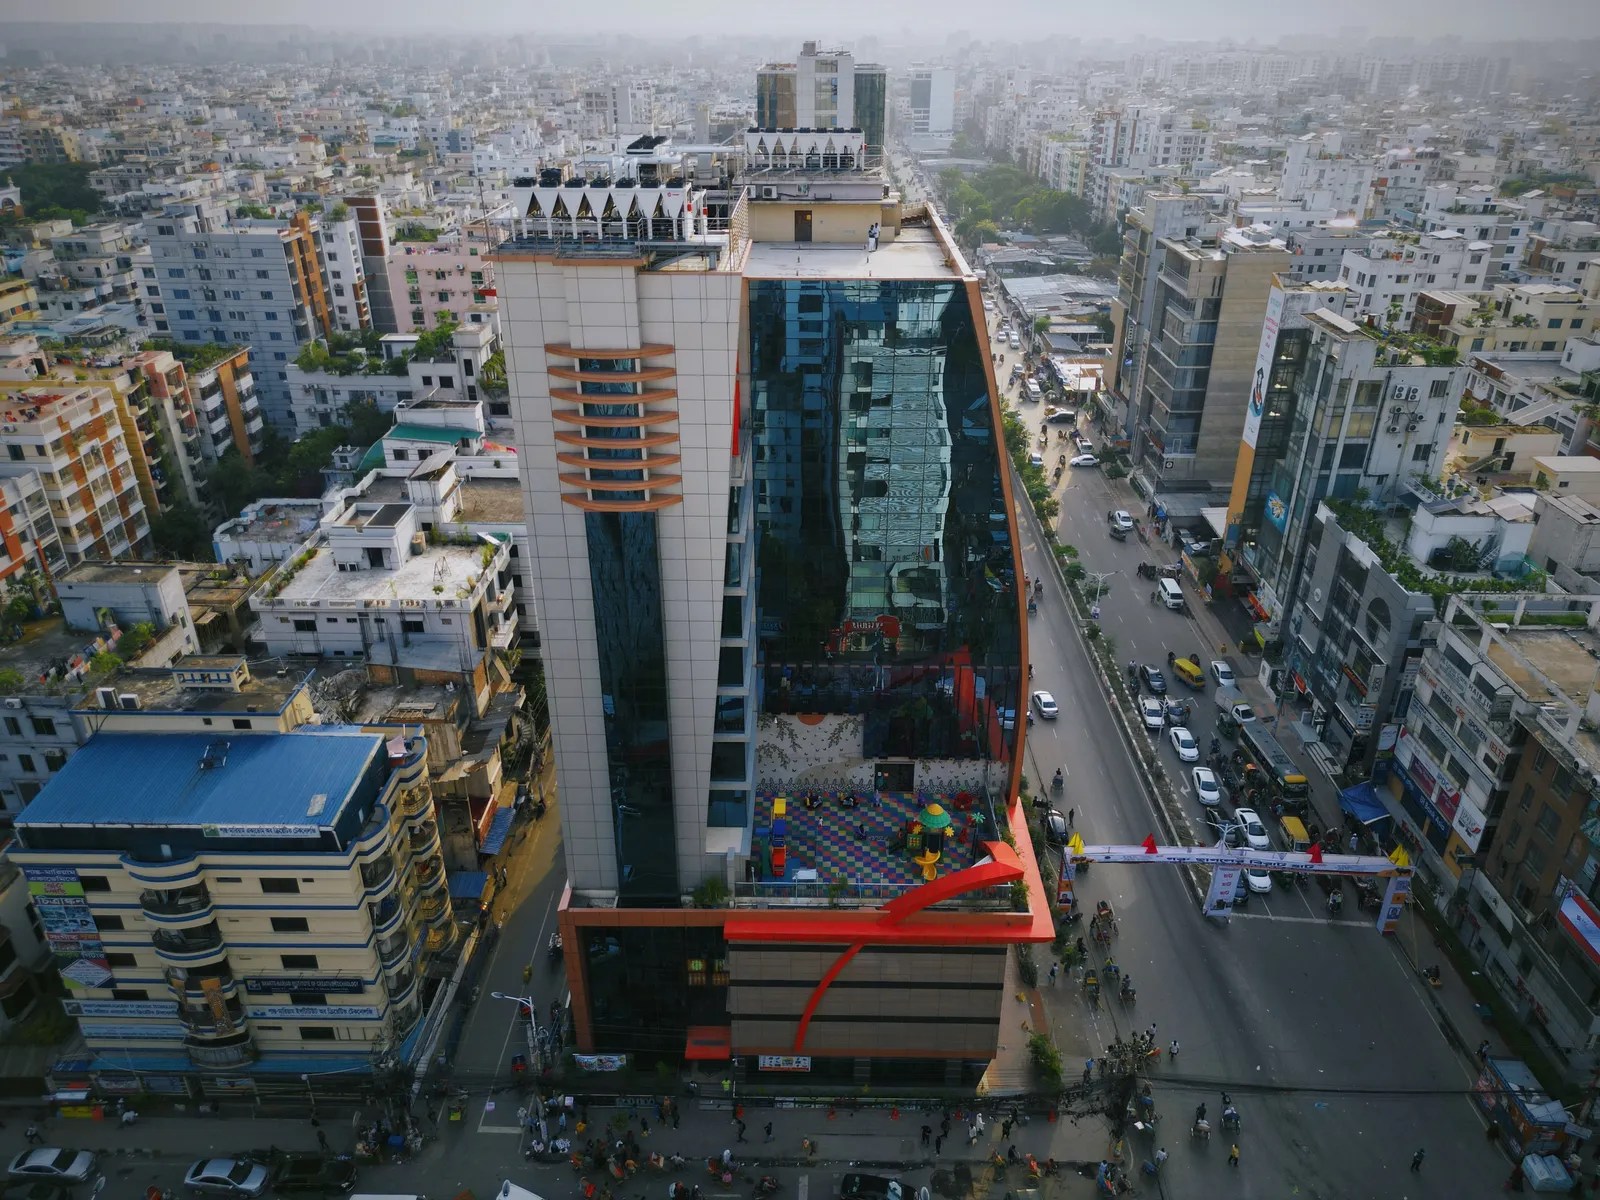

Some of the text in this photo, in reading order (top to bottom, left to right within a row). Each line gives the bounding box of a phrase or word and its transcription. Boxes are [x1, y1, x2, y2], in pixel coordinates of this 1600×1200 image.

[1440, 689, 1453, 706] TOEFL
[1468, 684, 1482, 701] HAIR
[1467, 719, 1488, 742] SPOKEN
[1490, 740, 1506, 762] IELTS
[1437, 772, 1450, 789] IPDC
[1424, 801, 1436, 819] Bank
